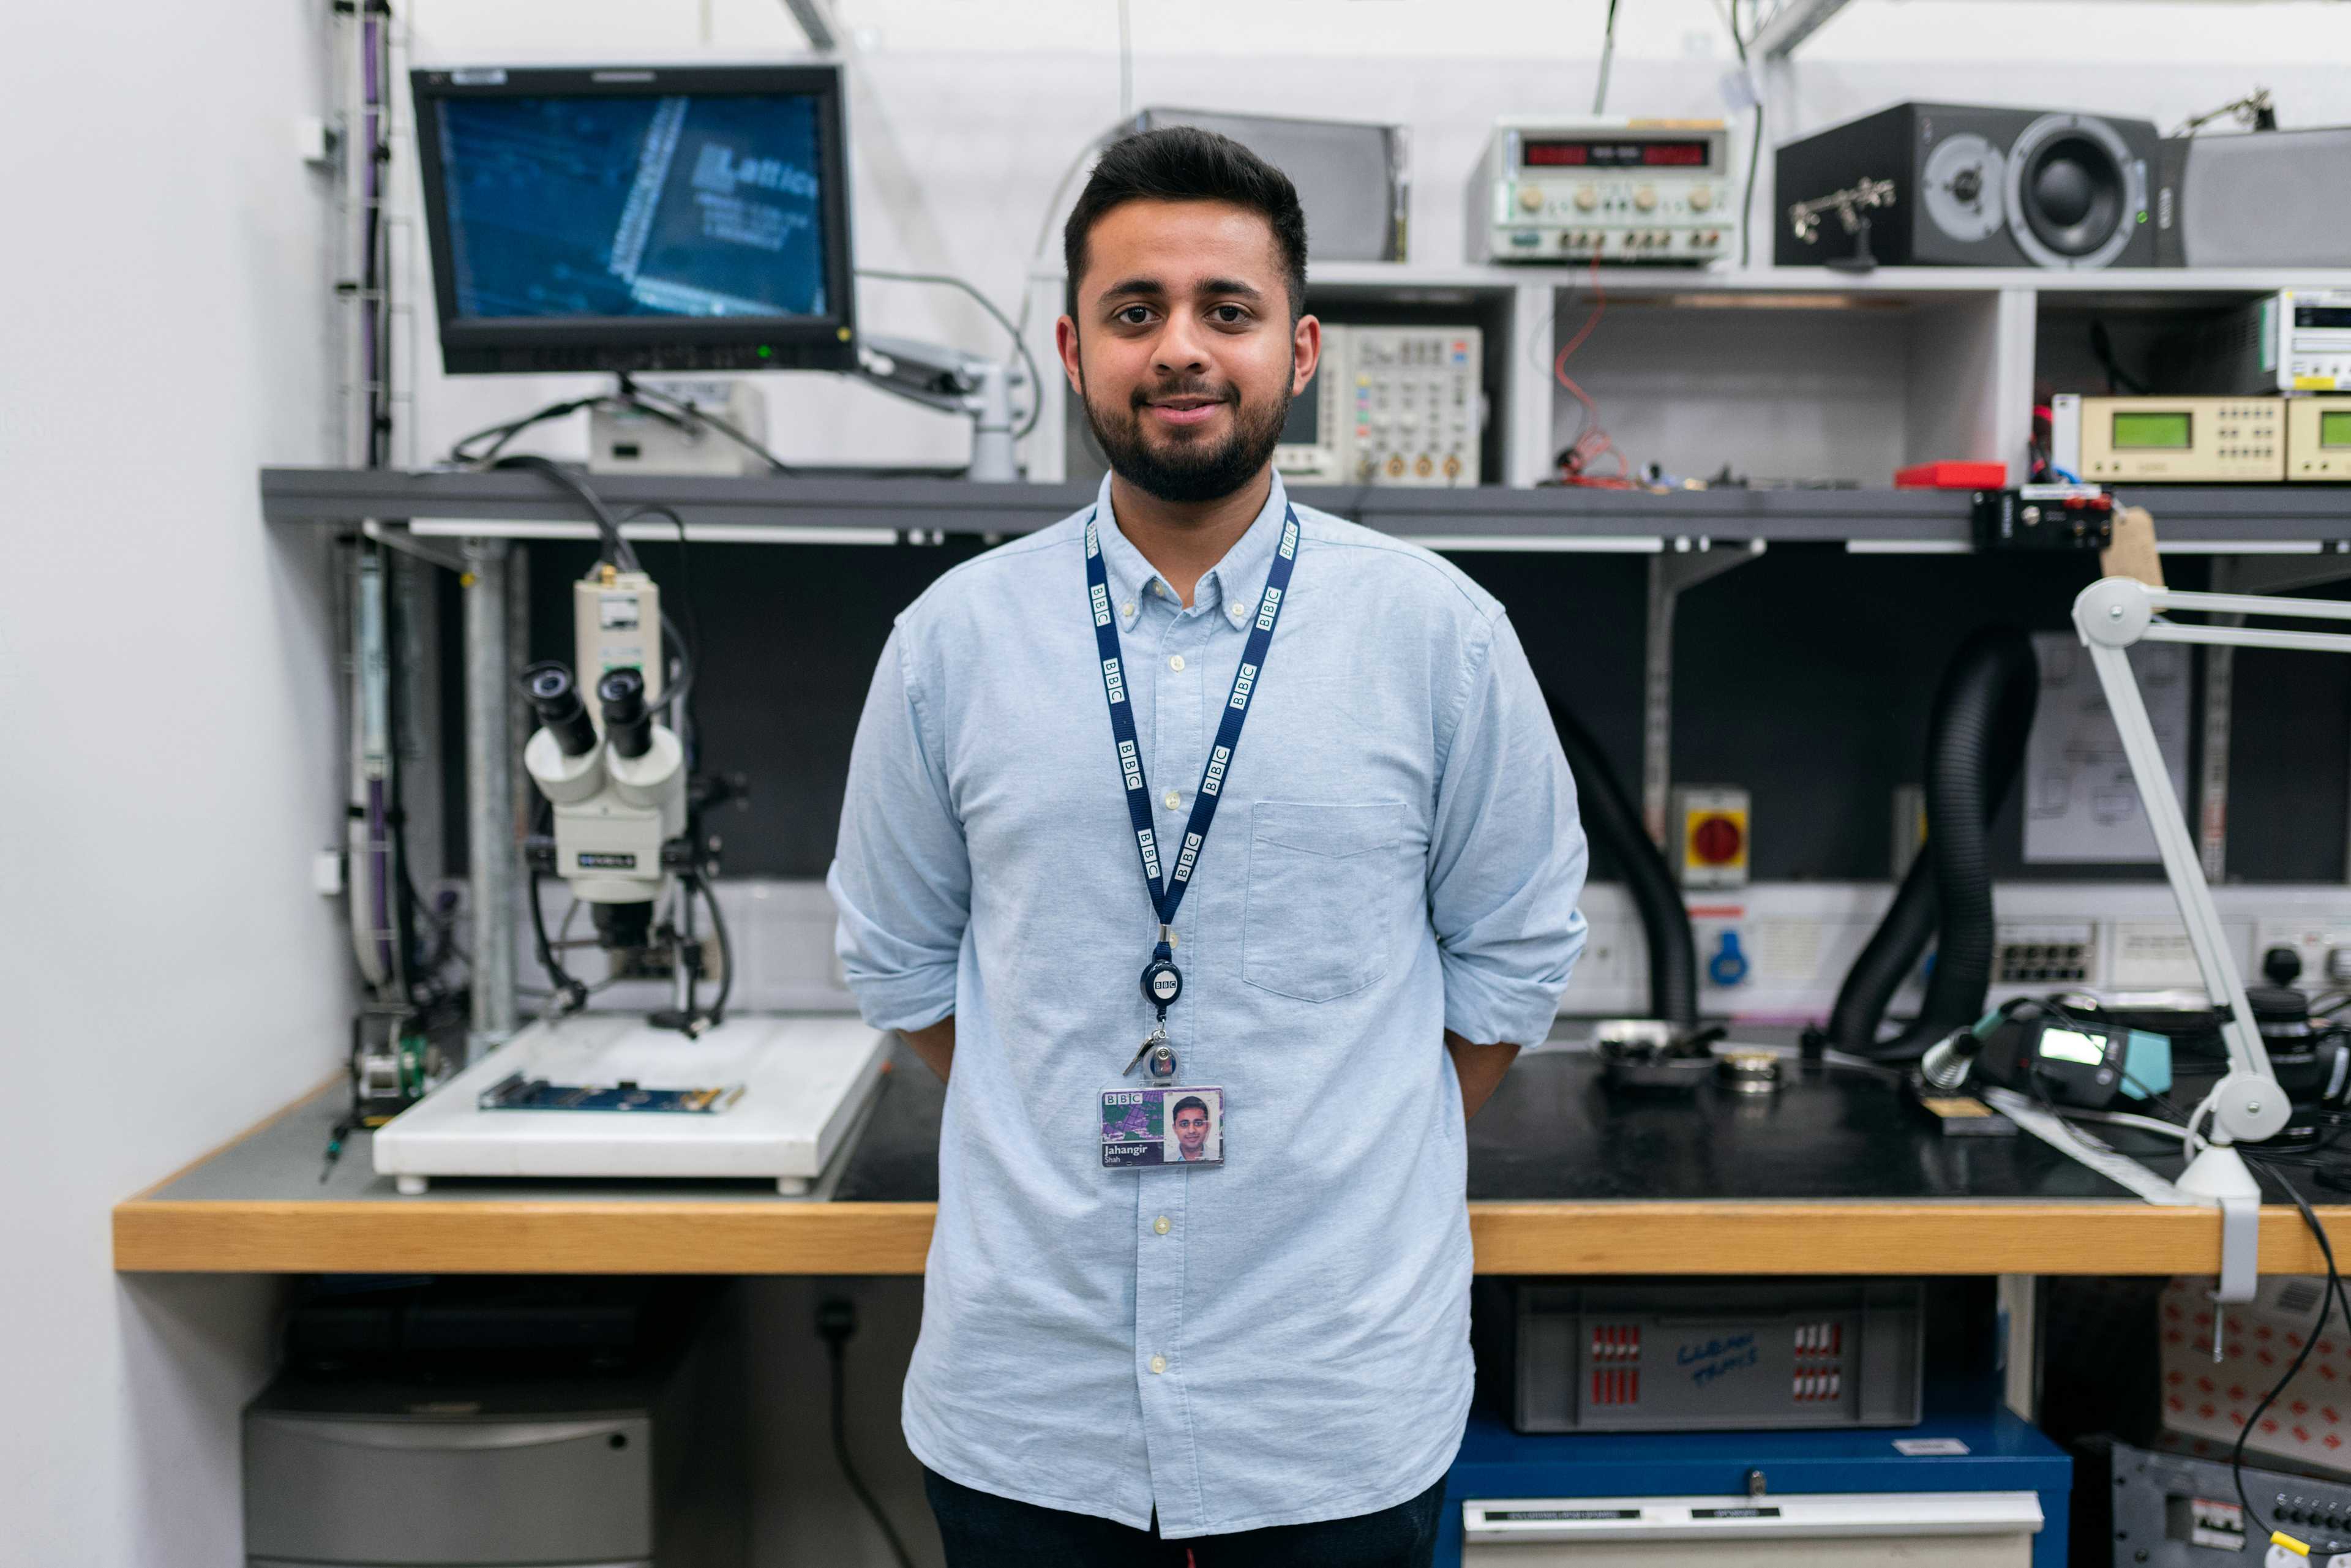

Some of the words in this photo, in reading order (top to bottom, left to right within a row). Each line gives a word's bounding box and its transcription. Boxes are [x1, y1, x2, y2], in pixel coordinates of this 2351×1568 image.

[1087, 522, 1098, 557] BBC
[1281, 522, 1297, 558] BBC
[1092, 586, 1109, 625] BBC
[1258, 588, 1280, 629] BBC
[1104, 659, 1123, 702] BBC
[1231, 665, 1255, 708] BBC
[1120, 742, 1141, 789] BBC
[1204, 747, 1228, 793] BBC
[1139, 831, 1159, 877] BBC
[1176, 834, 1200, 880] BBC
[1106, 1093, 1141, 1104] BBC
[1104, 1144, 1148, 1157] Jahangir
